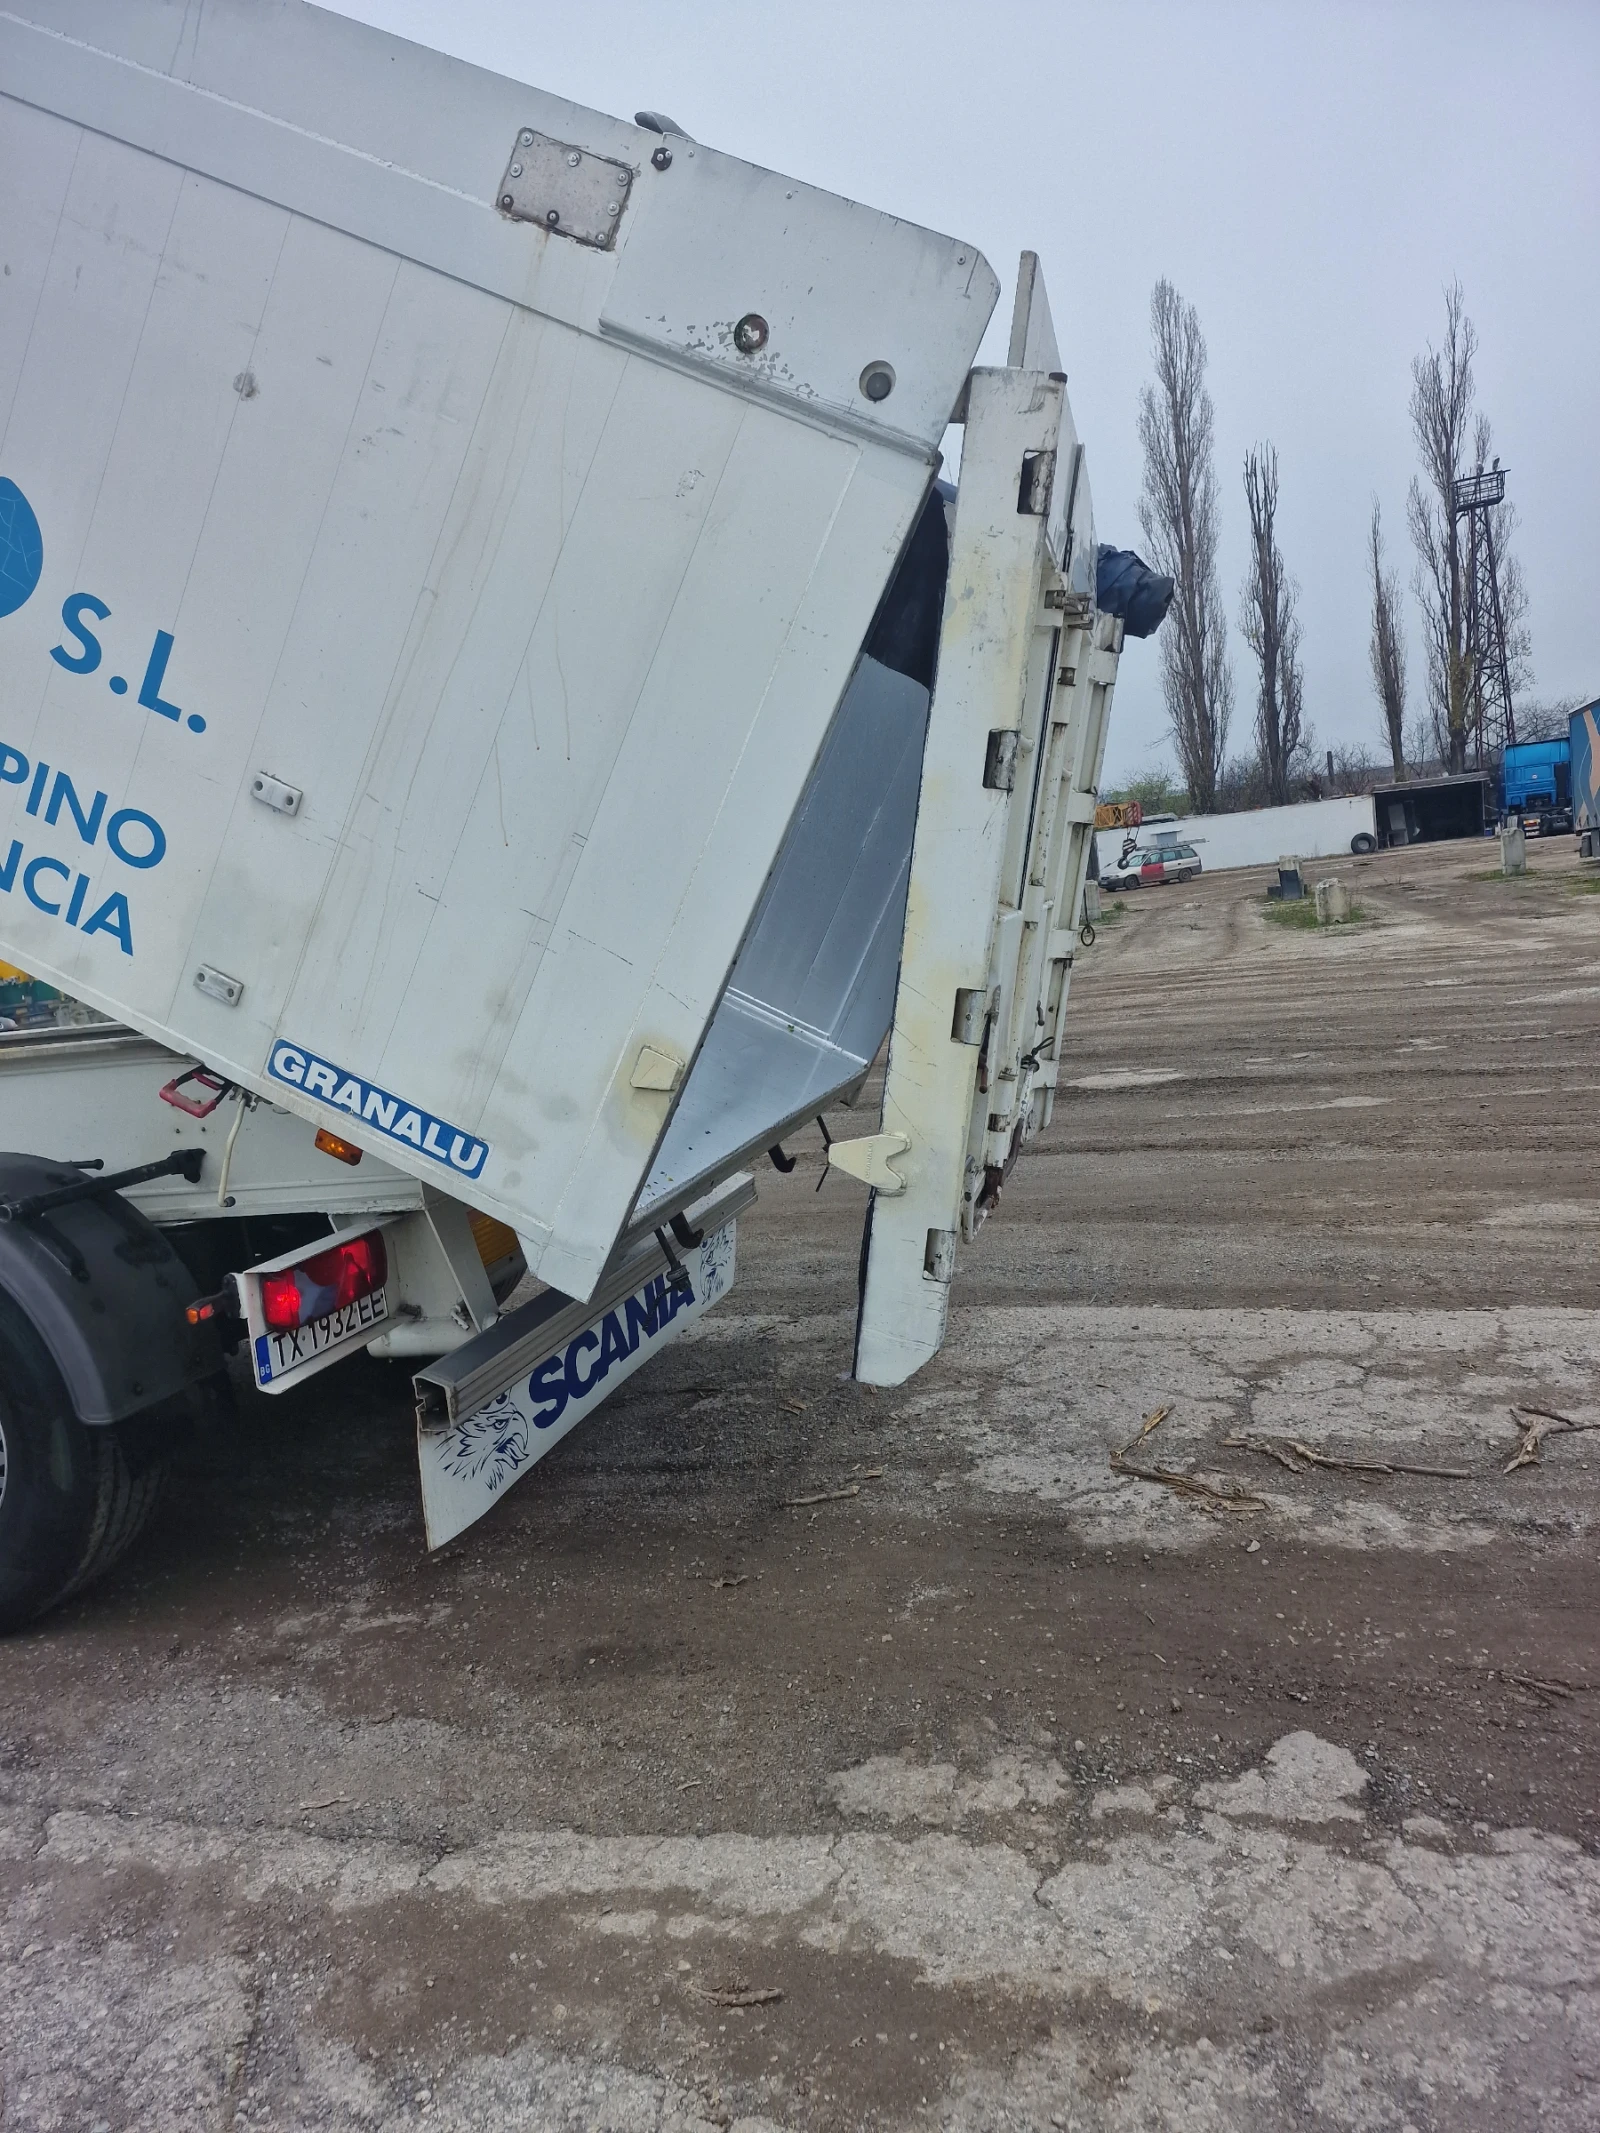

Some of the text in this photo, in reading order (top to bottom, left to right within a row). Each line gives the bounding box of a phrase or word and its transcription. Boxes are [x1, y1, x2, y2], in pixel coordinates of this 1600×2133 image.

[49, 592, 207, 734] S.L.
[273, 1046, 484, 1171] GRANALU
[260, 1363, 271, 1377] BG
[528, 1272, 696, 1429] SCANIA
